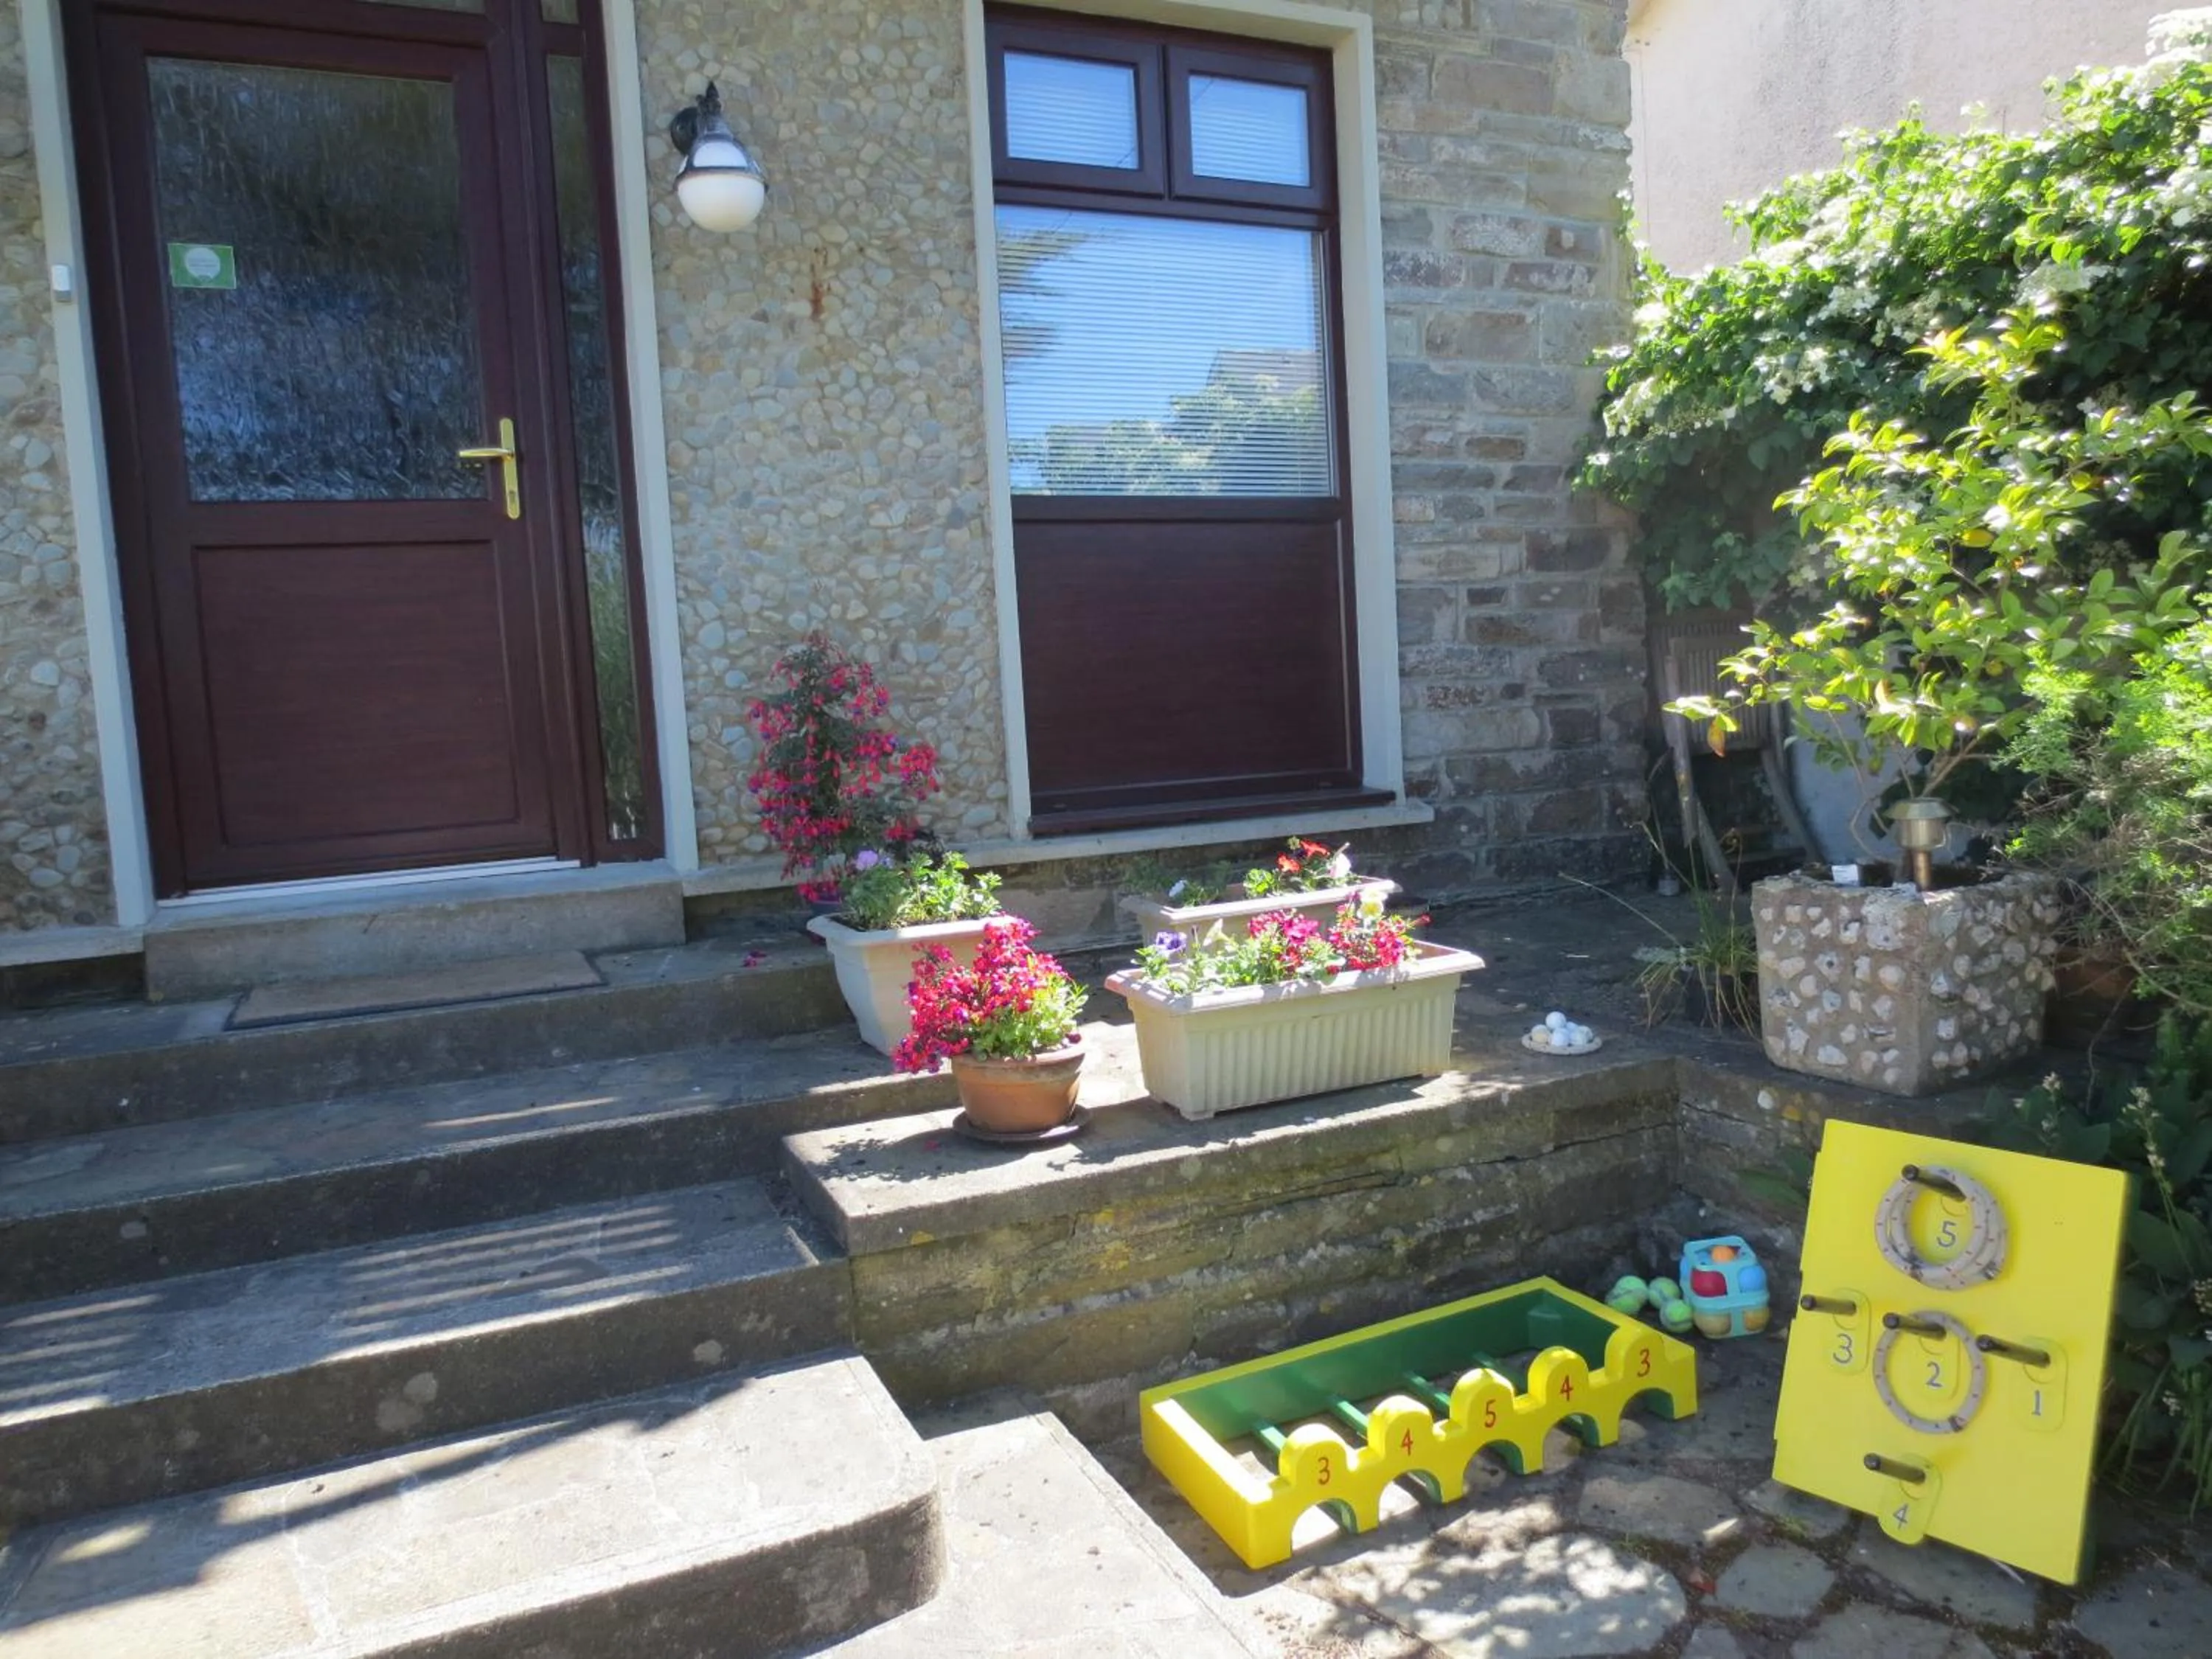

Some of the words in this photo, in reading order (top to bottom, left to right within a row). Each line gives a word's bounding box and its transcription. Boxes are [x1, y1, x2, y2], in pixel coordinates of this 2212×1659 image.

[1936, 1220, 1957, 1248] 5
[1832, 1333, 1853, 1364] 3
[1926, 1362, 1944, 1389] 2
[1318, 1457, 1330, 1485] 3
[1401, 1428, 1413, 1456] 4
[1484, 1399, 1498, 1428] 5
[1559, 1374, 1573, 1402] 4
[1637, 1348, 1652, 1377] 3
[2031, 1390, 2042, 1416] 1
[1893, 1503, 1908, 1530] 4
